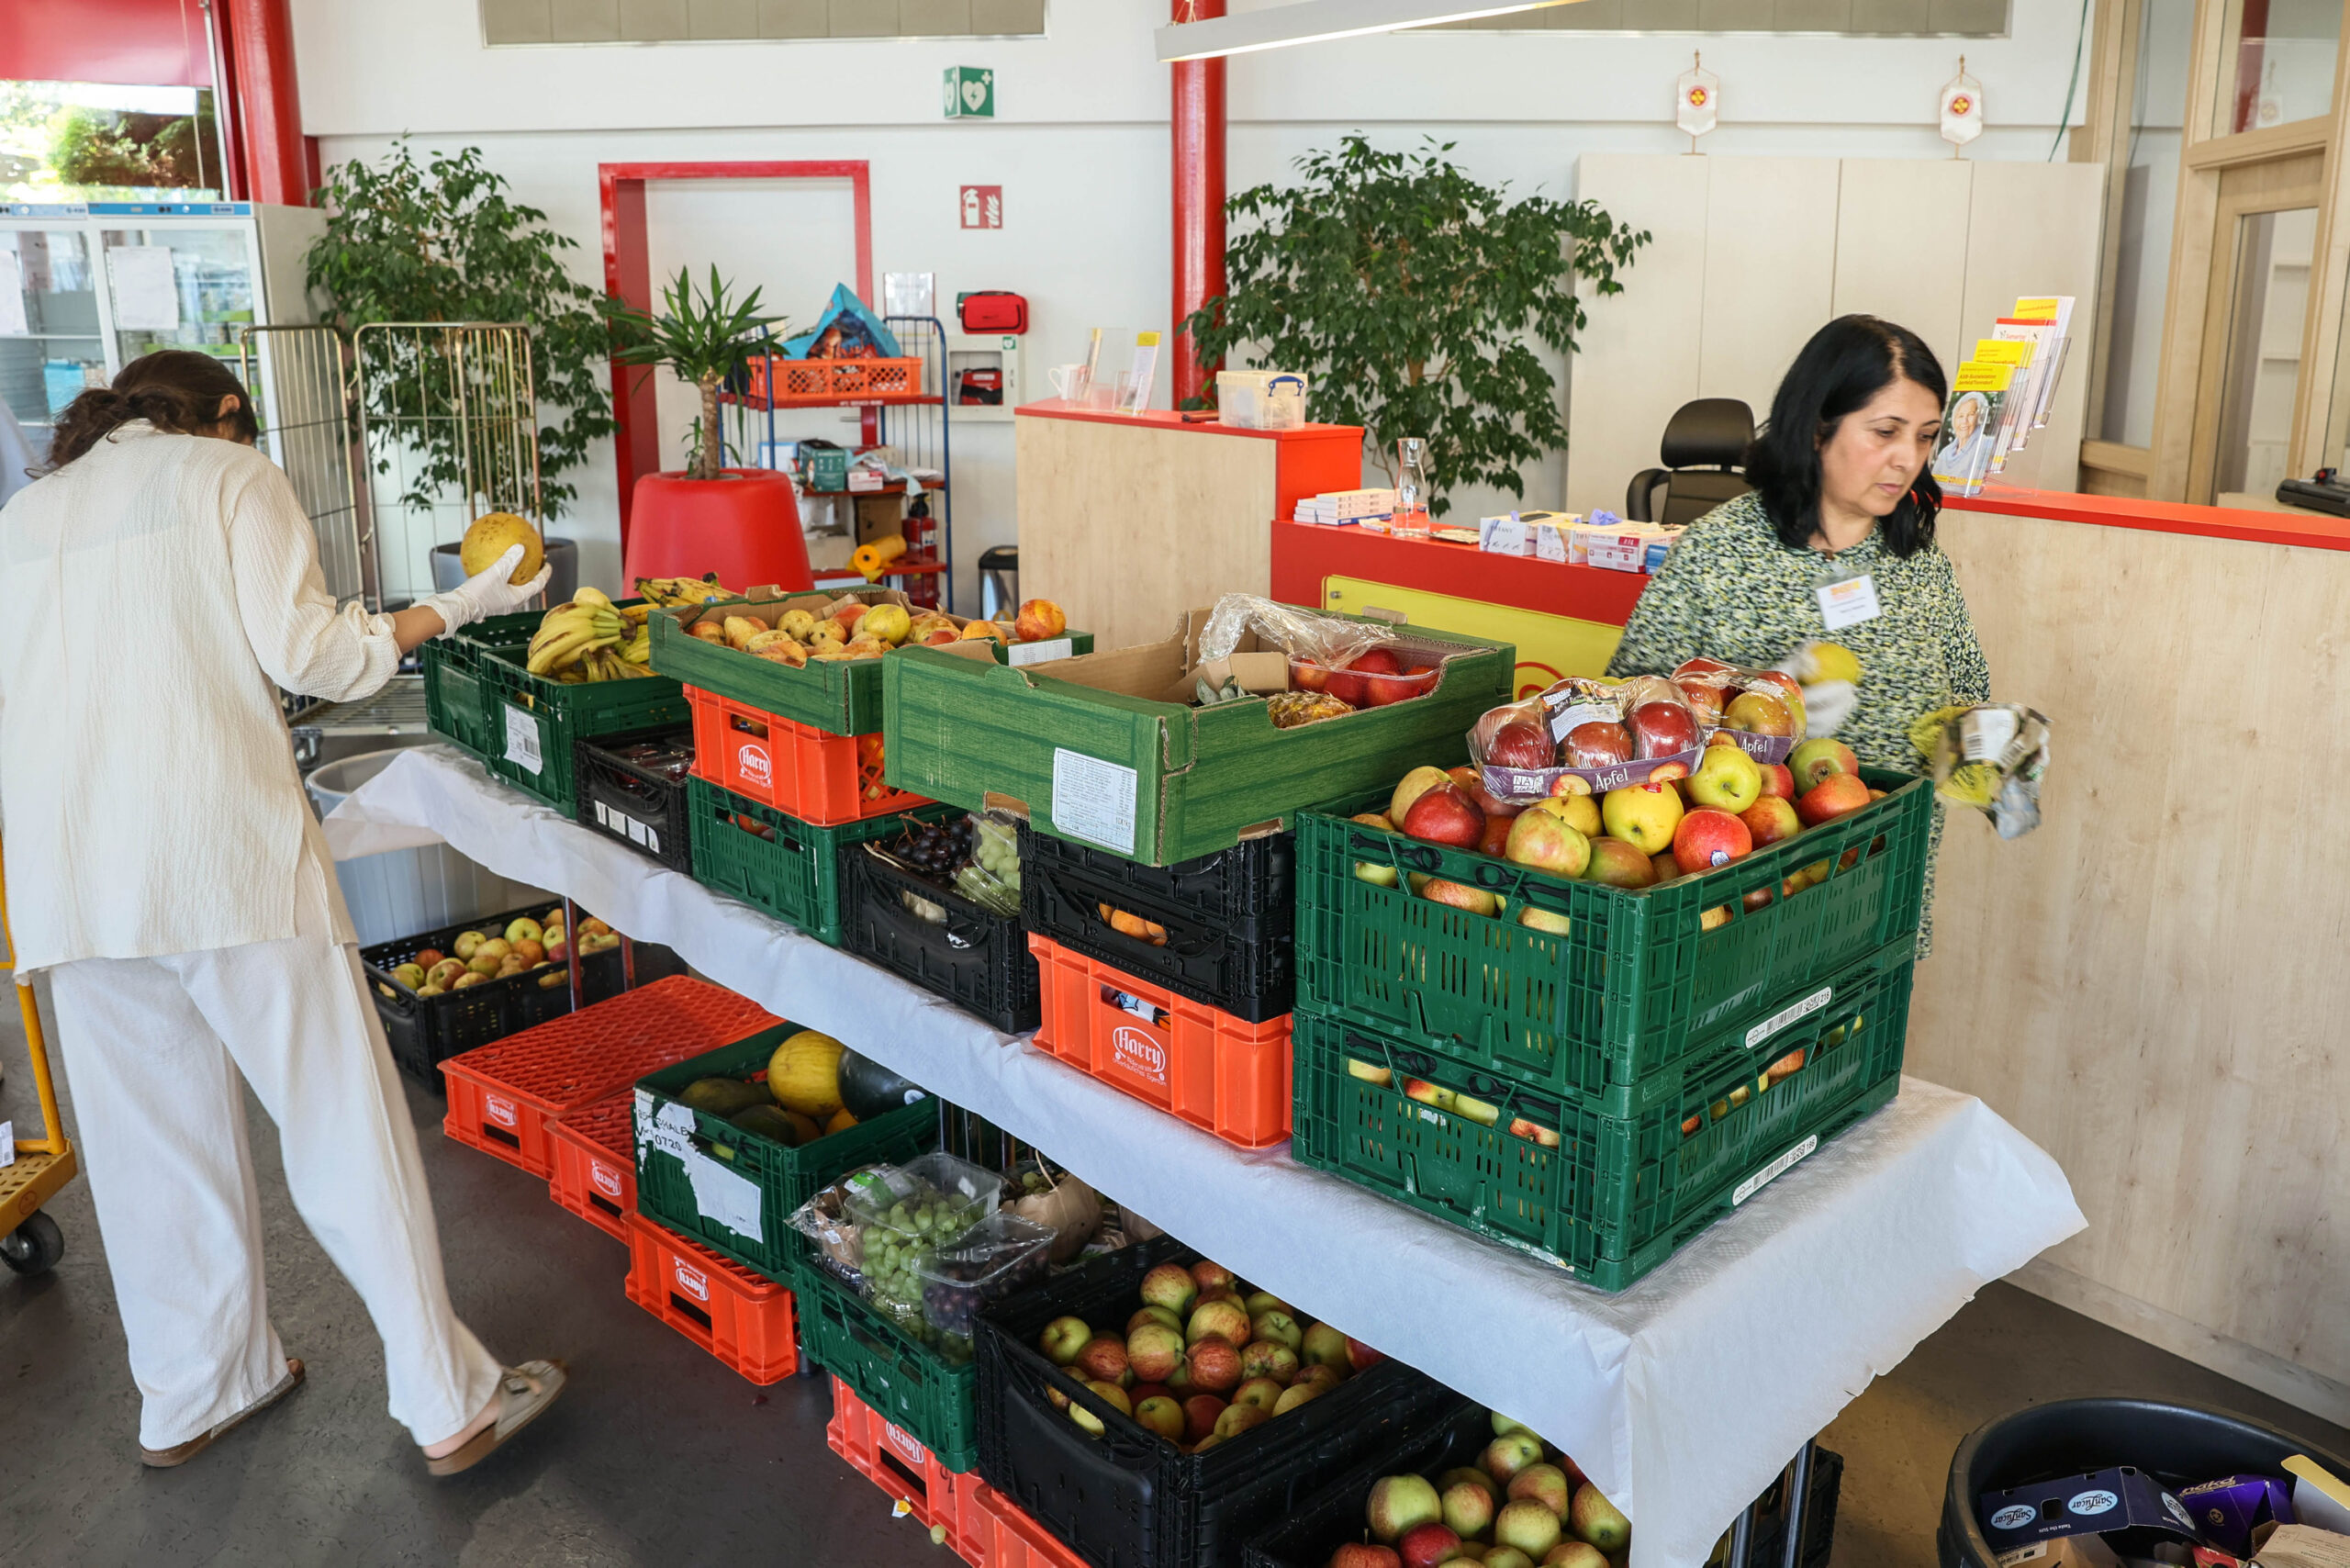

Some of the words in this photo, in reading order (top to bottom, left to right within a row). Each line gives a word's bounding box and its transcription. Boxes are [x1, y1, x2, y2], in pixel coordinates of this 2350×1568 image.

[1741, 735, 1768, 755] Äpfel
[742, 748, 770, 778] Harry
[1595, 767, 1628, 790] Äpfel
[1118, 1028, 1161, 1072] Harry
[679, 1269, 707, 1300] Harry
